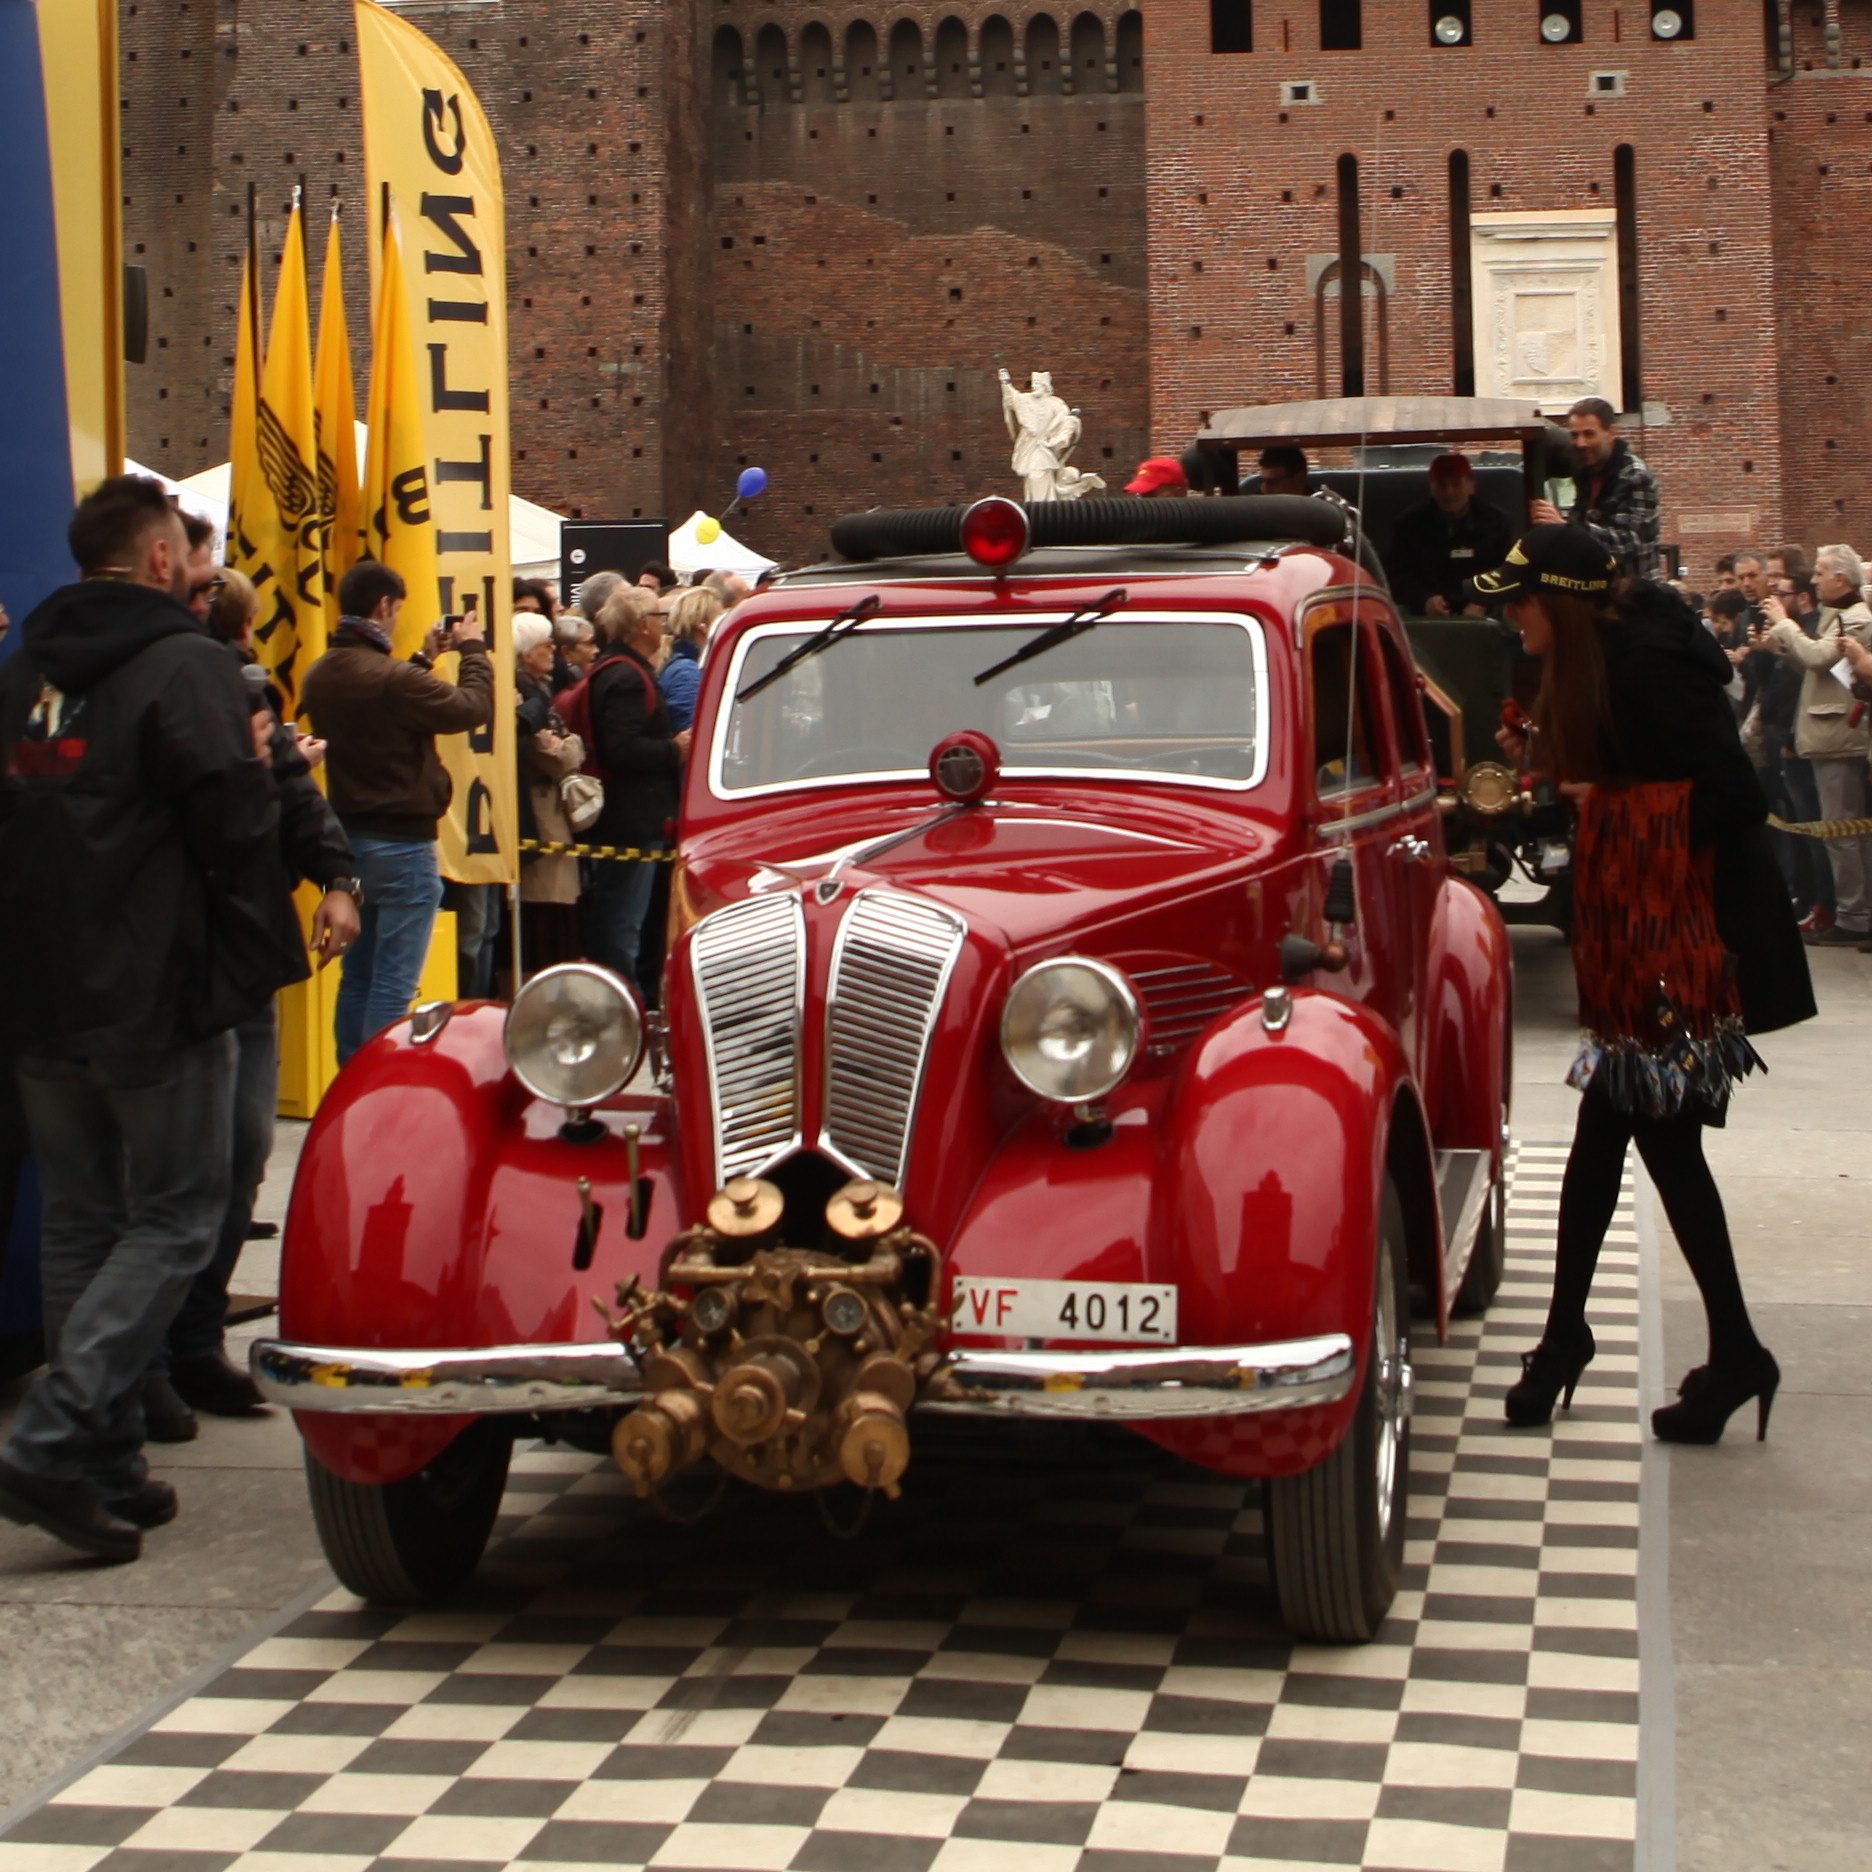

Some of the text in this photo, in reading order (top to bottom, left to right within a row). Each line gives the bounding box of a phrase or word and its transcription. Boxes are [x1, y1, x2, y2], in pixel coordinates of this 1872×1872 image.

[1539, 572, 1609, 591] BREITLING
[968, 1288, 1161, 1334] VF 4012
